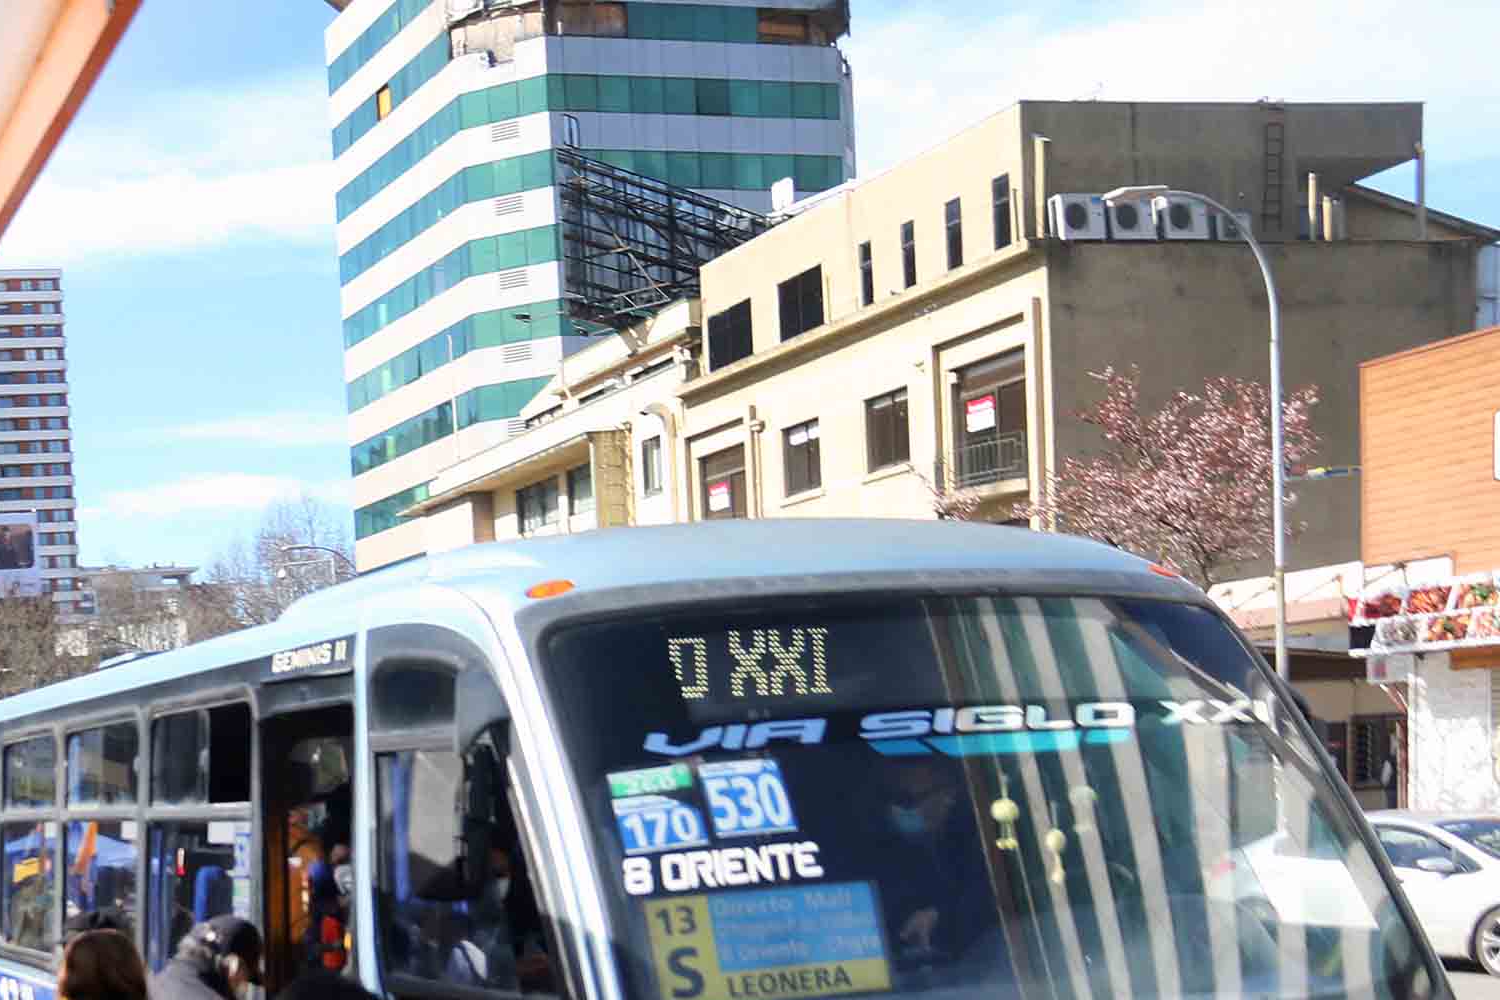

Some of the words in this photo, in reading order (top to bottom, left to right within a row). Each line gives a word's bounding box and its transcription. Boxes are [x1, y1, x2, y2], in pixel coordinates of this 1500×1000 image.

[728, 627, 834, 697] XXI
[643, 718, 827, 756] VIA
[858, 701, 1136, 740] SIGLO
[621, 808, 700, 849] 170
[704, 773, 791, 831] 530
[622, 857, 654, 895] 8
[659, 840, 824, 892] ORIENTE
[655, 906, 697, 936] 13
[667, 947, 706, 999] S
[726, 965, 853, 999] LEONERA
